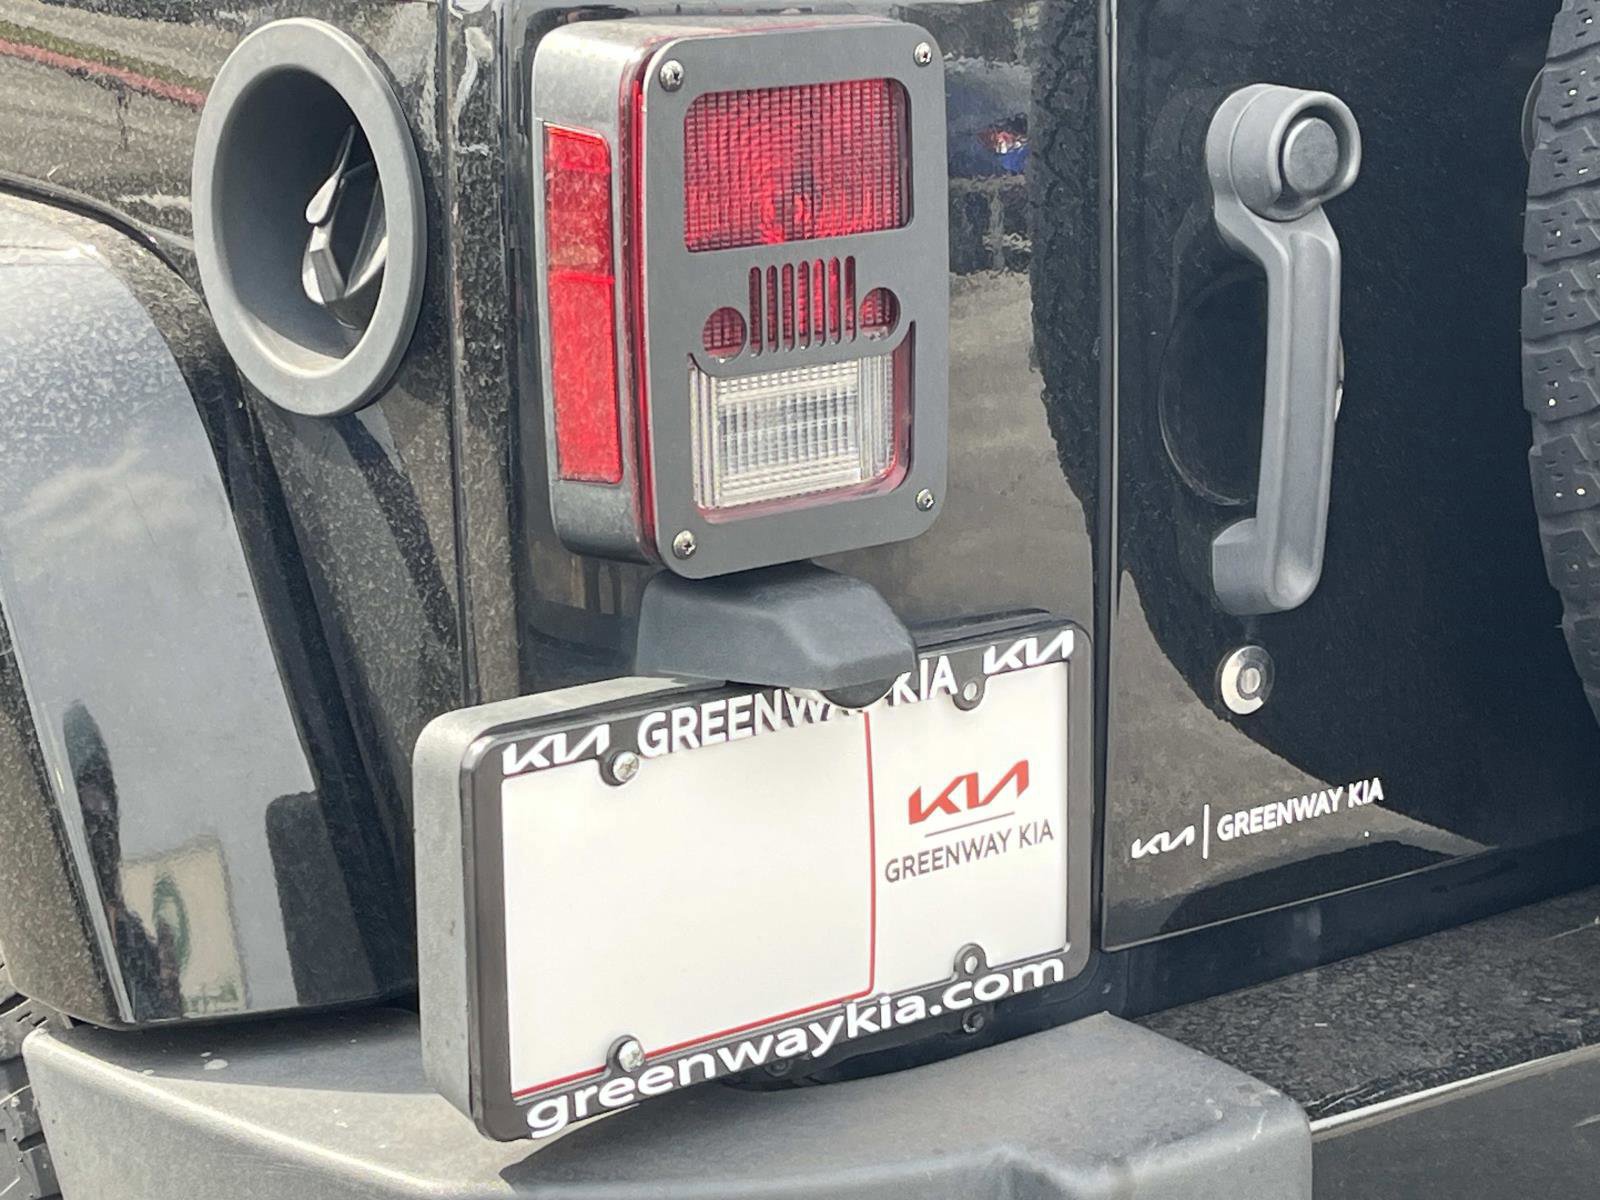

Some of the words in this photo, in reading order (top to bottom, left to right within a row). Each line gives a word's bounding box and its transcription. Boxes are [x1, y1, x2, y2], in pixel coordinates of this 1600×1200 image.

[891, 655, 958, 706] KIA
[1216, 785, 1344, 842] GREENWAY
[1348, 776, 1385, 809] KIA
[884, 827, 1013, 884] GREENWAY
[1018, 818, 1055, 849] KIA
[526, 957, 1064, 1138] greenwaykia.com
